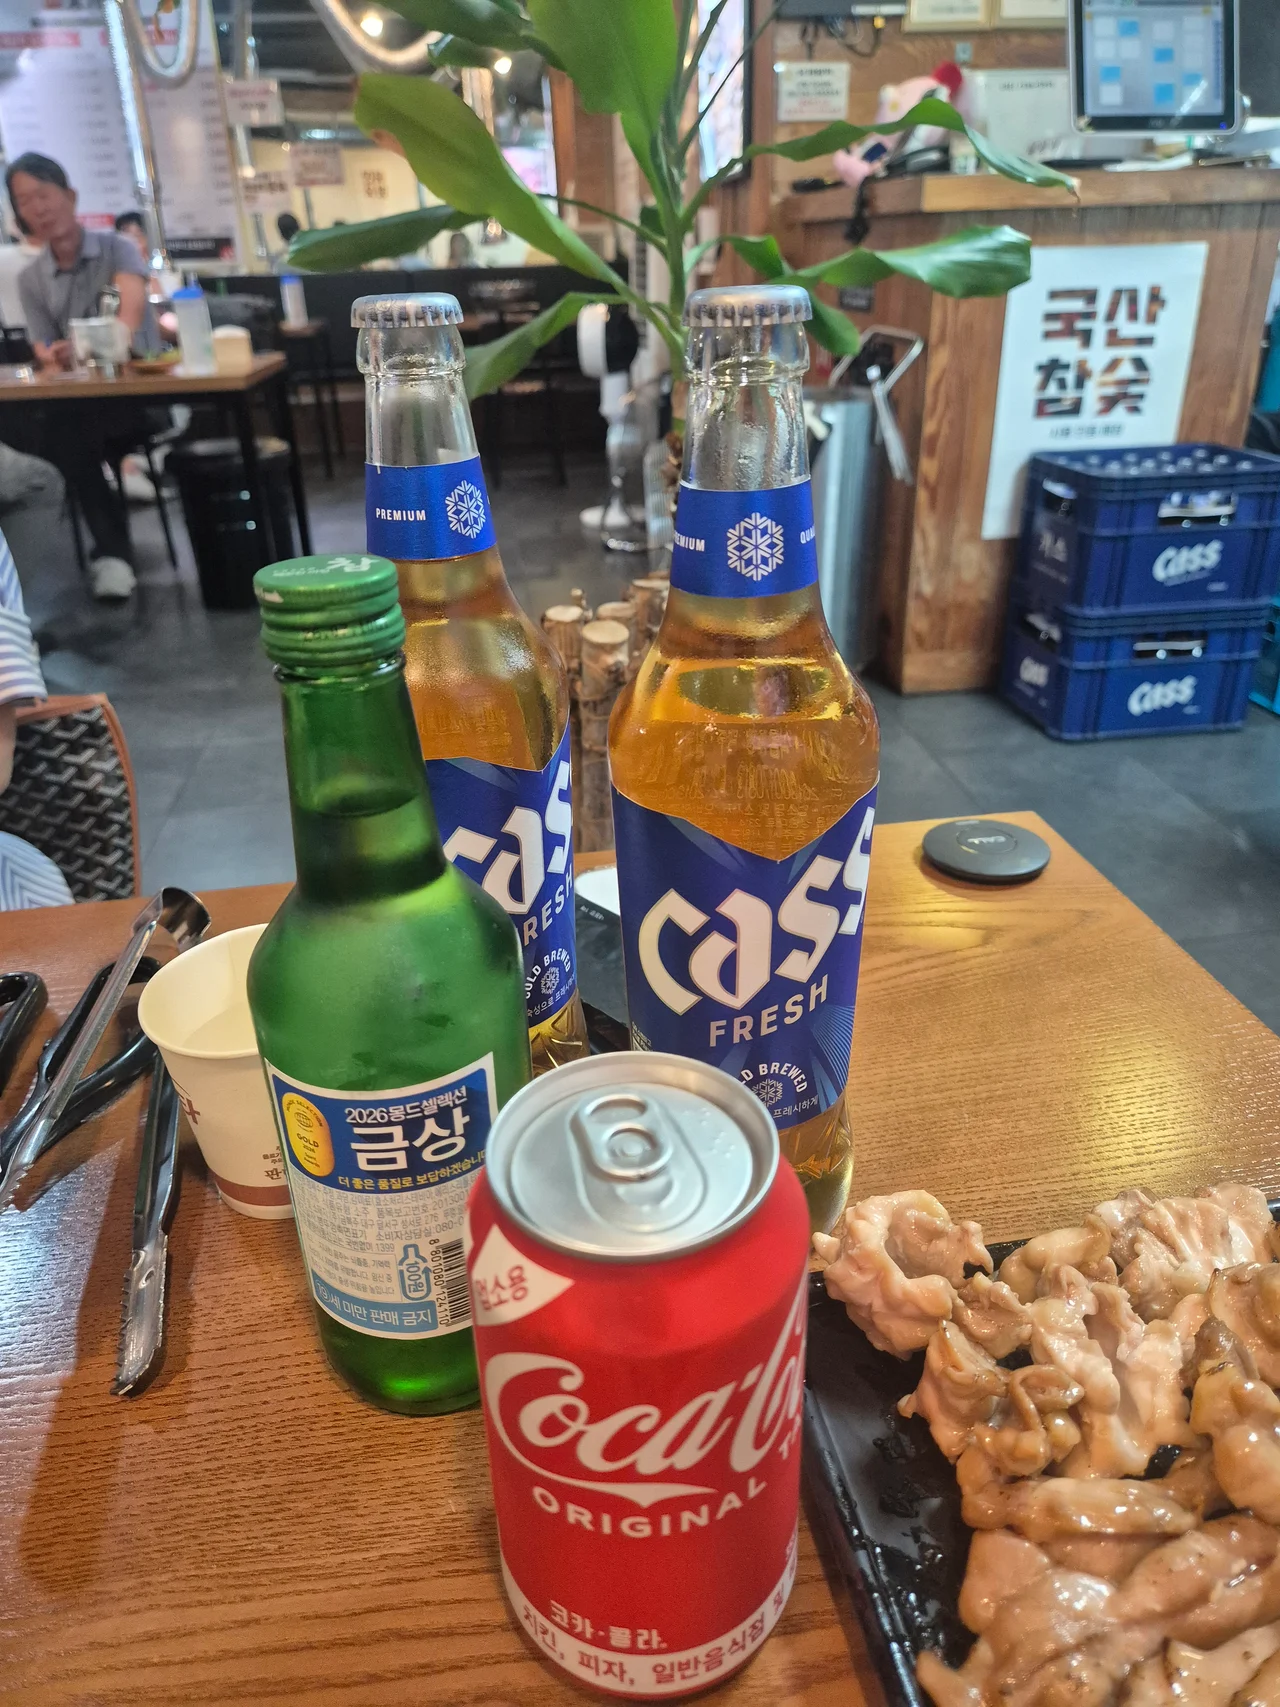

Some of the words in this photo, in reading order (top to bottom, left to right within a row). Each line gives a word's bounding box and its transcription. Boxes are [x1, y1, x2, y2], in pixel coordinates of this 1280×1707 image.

[1043, 286, 1166, 349] 국산
[375, 507, 426, 522] PREMIUM
[523, 864, 574, 947] RESH
[543, 948, 571, 973] BREWED
[708, 974, 829, 1048] FRESH
[758, 1062, 808, 1093] BREWED
[344, 1084, 468, 1124] 2026몽드셀렉션
[773, 1094, 819, 1119] 프레시하게
[296, 1132, 319, 1148] GOLD
[350, 1106, 470, 1171] 금상
[338, 1176, 350, 1188] 더
[378, 1175, 414, 1190] 품질로
[376, 1243, 395, 1253] 1399
[406, 1260, 425, 1294] 100원
[343, 1300, 368, 1321] 미만
[370, 1309, 399, 1326] 판매
[402, 1308, 432, 1326] 금지
[531, 1476, 769, 1538] ORIGINAL
[523, 1603, 565, 1661] 치킨,
[578, 1650, 635, 1686] 피자,
[652, 1611, 766, 1685] 일반음식점
